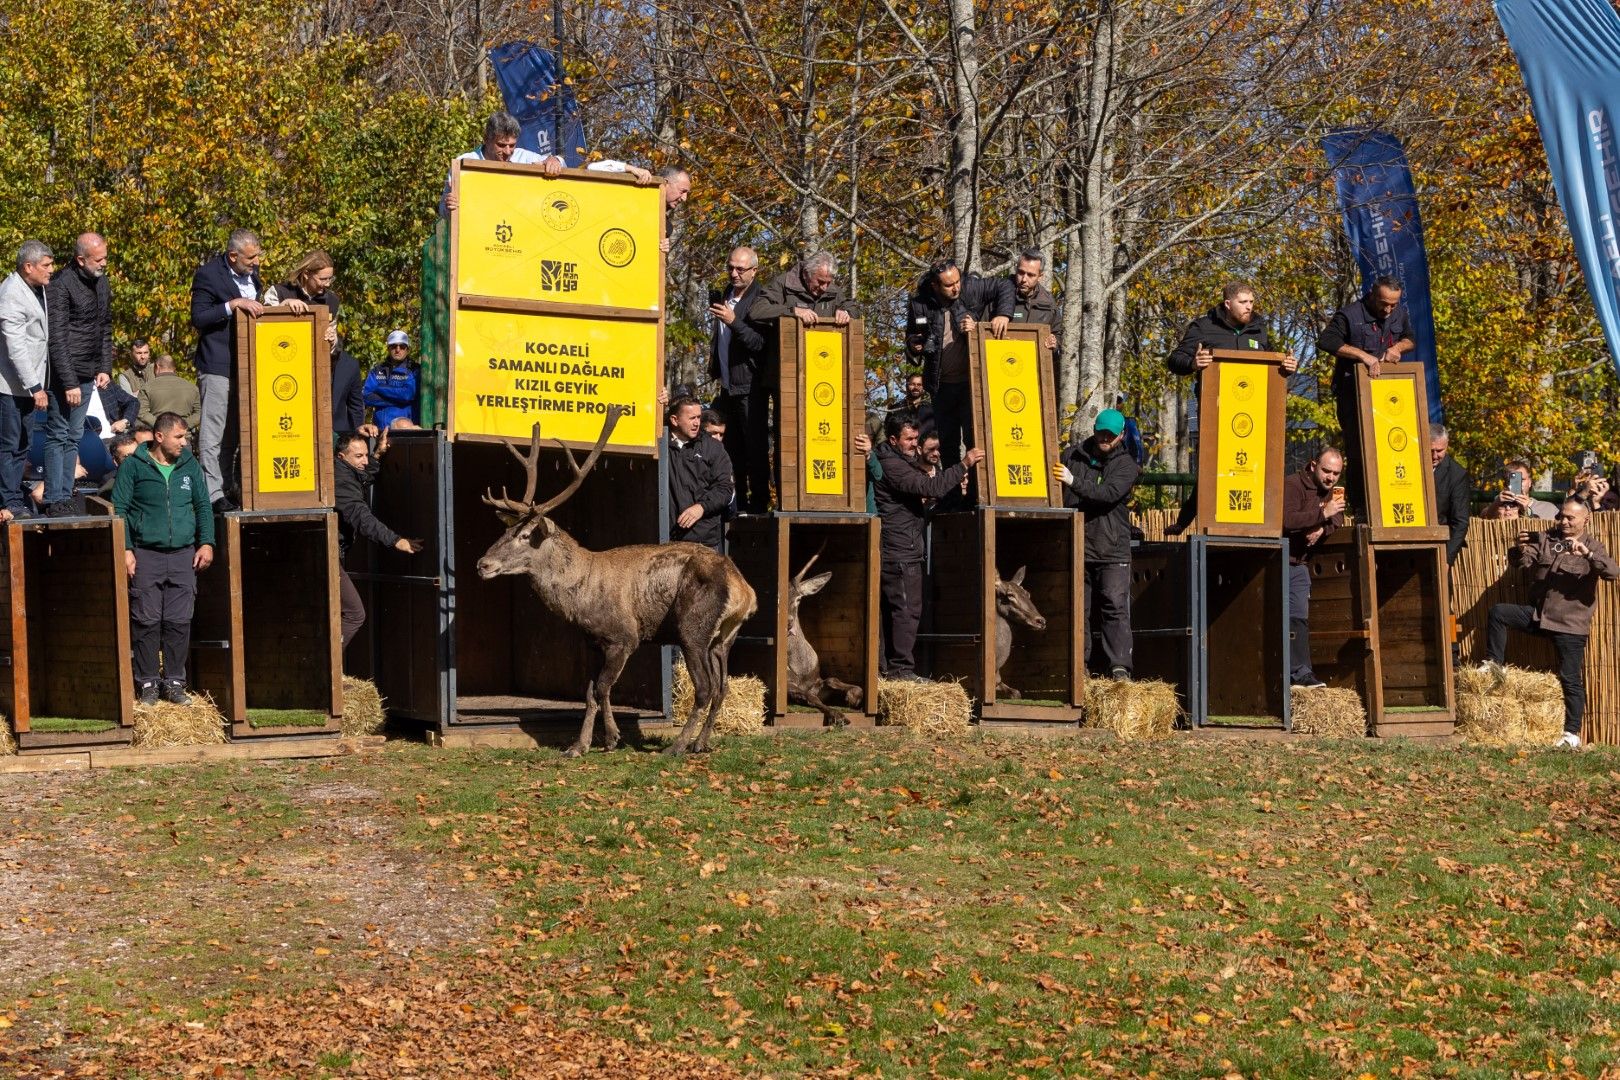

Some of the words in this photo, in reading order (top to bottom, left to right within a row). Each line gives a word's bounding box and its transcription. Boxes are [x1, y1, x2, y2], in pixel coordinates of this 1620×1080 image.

[525, 342, 589, 358] KOCAELİ
[488, 358, 557, 374] SAMANLI
[560, 361, 625, 379] DAĞLARI
[515, 378, 551, 393] KIZIL
[554, 380, 598, 396] GEYİK
[476, 394, 573, 413] YERLEŞTİRME
[576, 401, 636, 417] PROSİ
